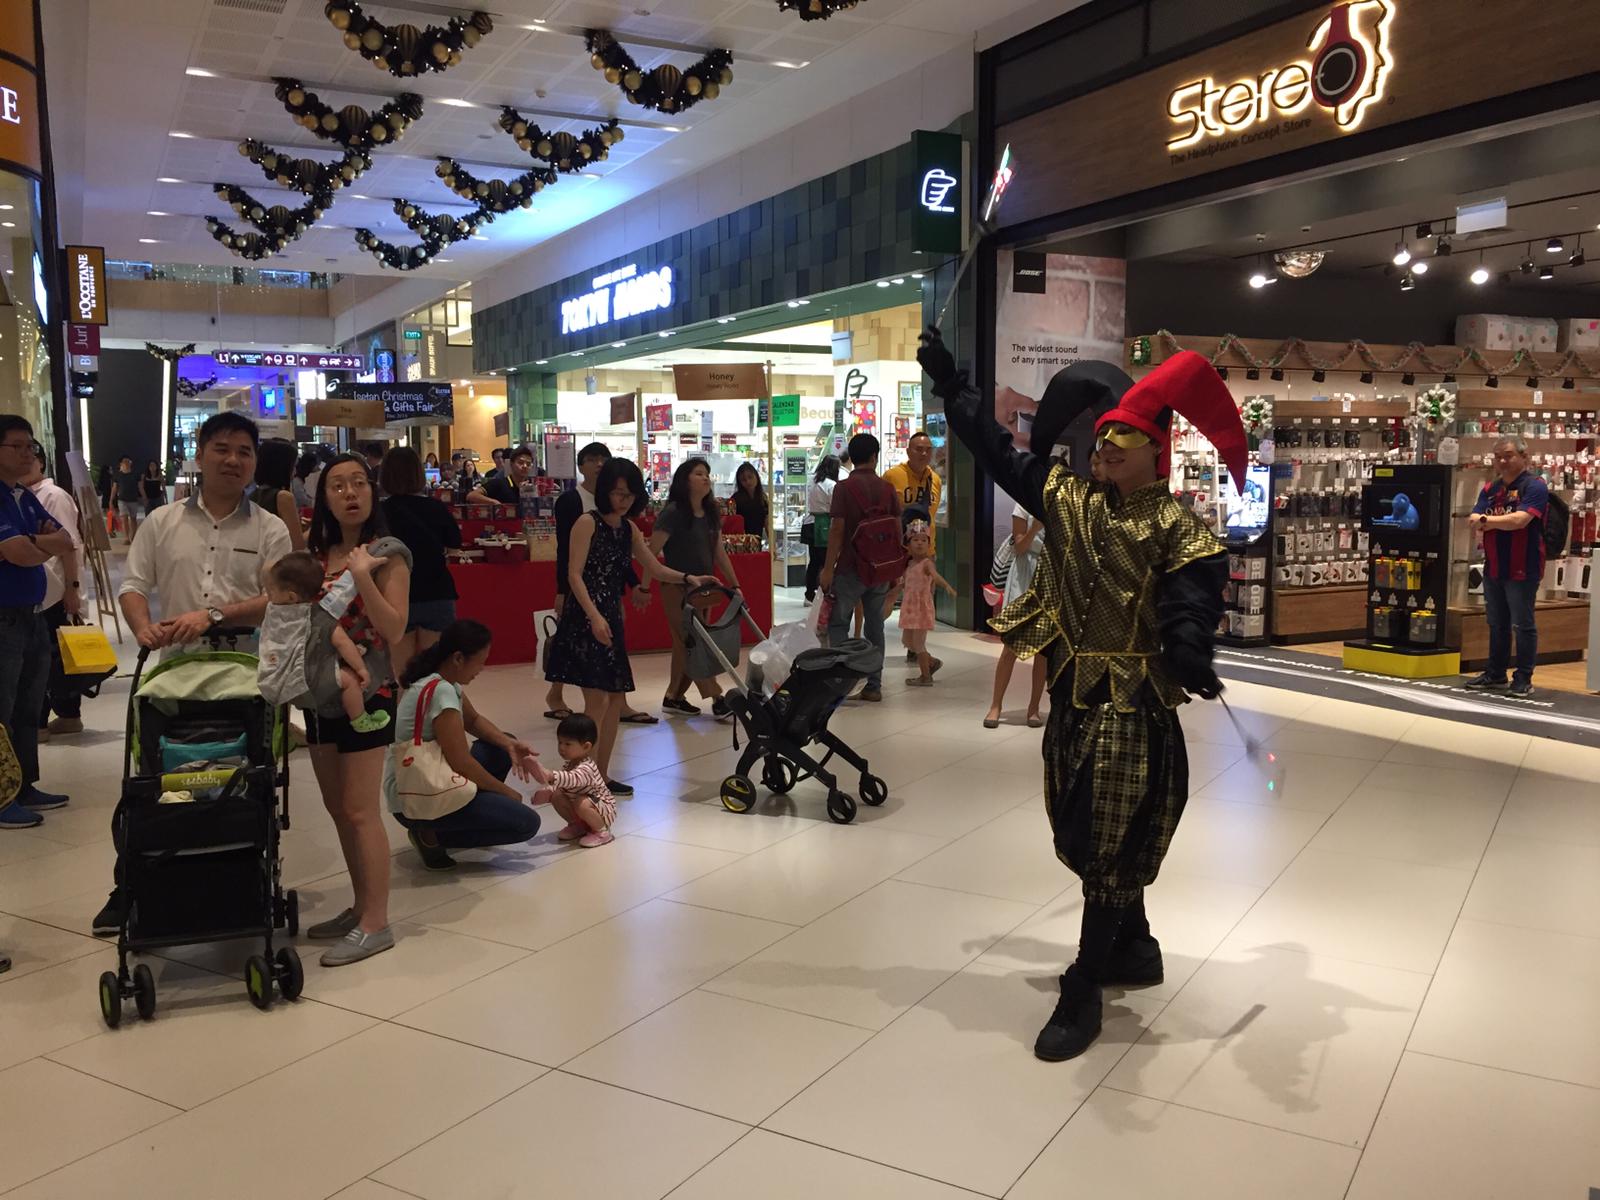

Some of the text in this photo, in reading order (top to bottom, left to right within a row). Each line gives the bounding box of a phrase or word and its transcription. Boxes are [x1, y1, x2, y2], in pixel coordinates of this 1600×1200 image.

[0, 86, 20, 124] E
[1170, 118, 1312, 166] The Headphone Concept Store
[78, 253, 92, 320] L'OCCITANE
[1012, 343, 1078, 354] The widest sound
[219, 353, 230, 364] L1
[1021, 357, 1035, 366] any
[1037, 357, 1059, 365] smart
[709, 372, 735, 381] Honey
[382, 390, 424, 401] Christmas
[392, 401, 415, 413] Gifts
[416, 401, 434, 413] Fair
[801, 407, 834, 420] Beau
[1250, 560, 1261, 627] BE OPEN
[1355, 672, 1410, 683] room
